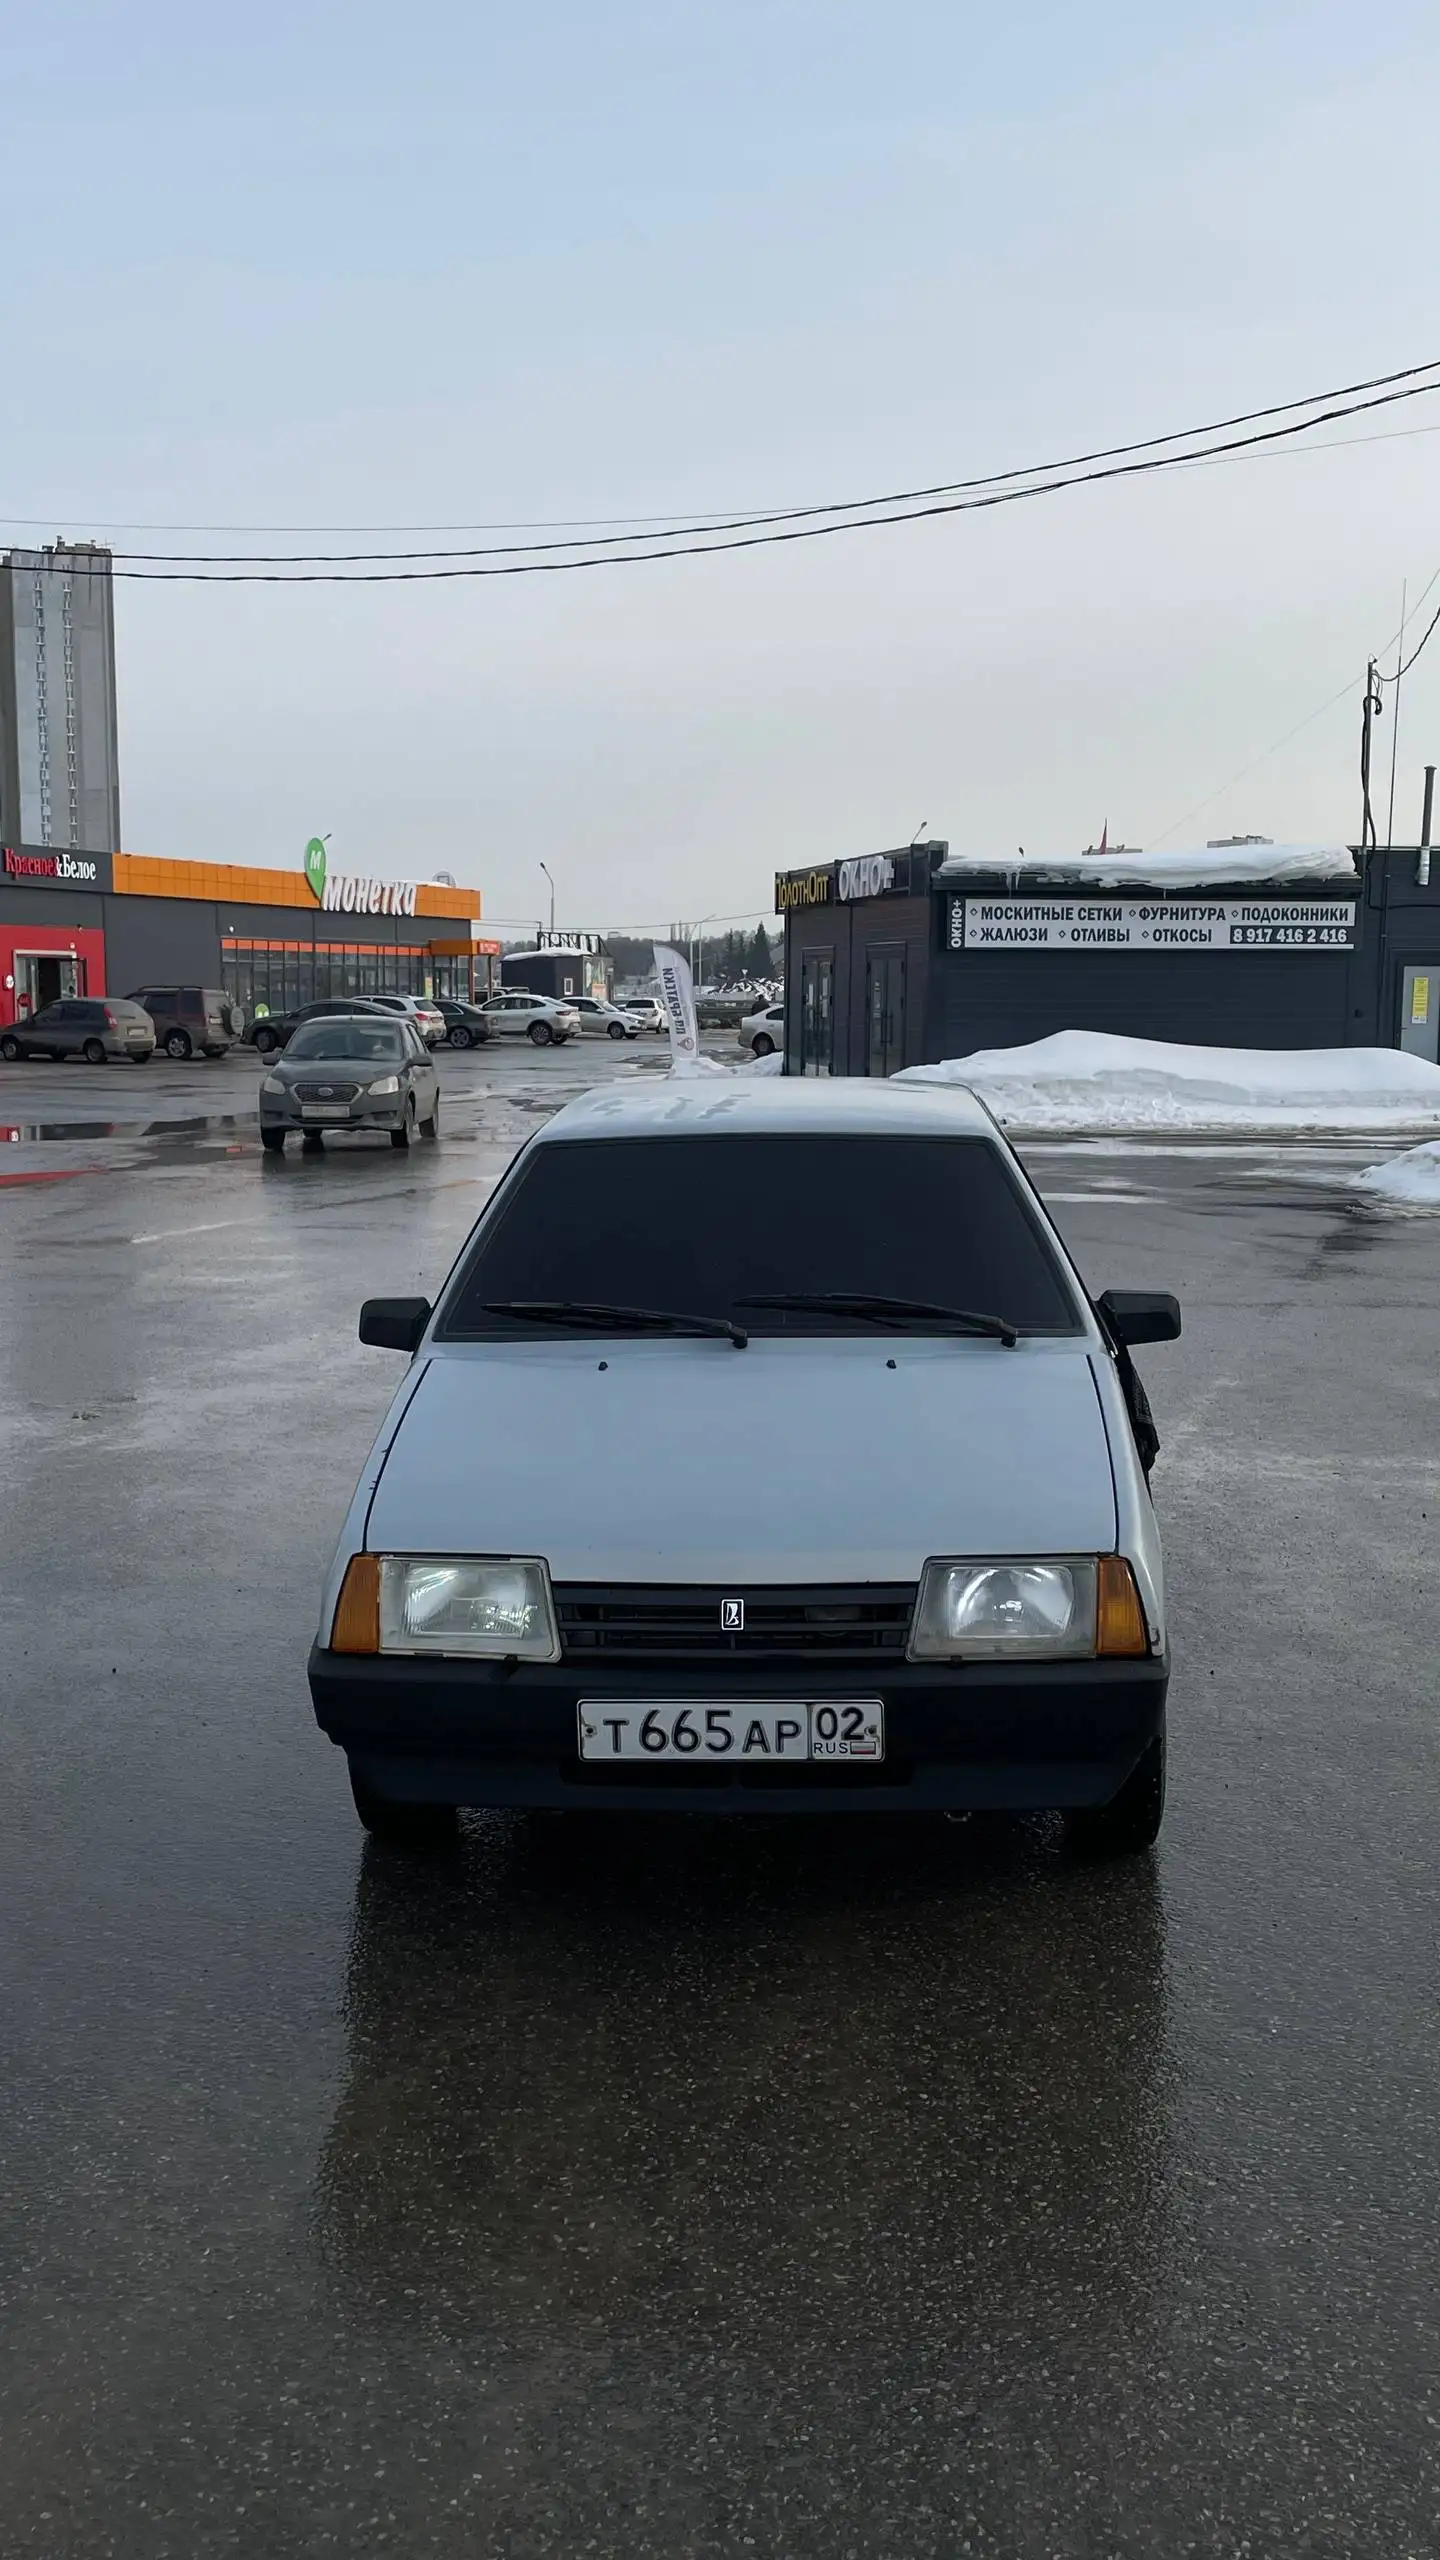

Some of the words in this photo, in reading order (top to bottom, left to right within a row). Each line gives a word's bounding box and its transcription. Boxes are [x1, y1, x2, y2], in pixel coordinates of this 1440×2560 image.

[980, 906, 1074, 921] МОСКИТНЫЕ
[1077, 907, 1123, 921] СЕТКИ
[1138, 907, 1226, 922] ФУРНИТУРА
[1241, 908, 1349, 923] ПОДОКОННИКИ
[951, 900, 963, 948] ОКНО+
[979, 927, 1048, 942] ЖАЛЮЗИ
[1070, 928, 1130, 943] ОТЛИВЫ
[1152, 928, 1212, 943] ОТКОСЫ
[1233, 928, 1244, 943] 8
[1246, 928, 1273, 943] 917
[1276, 928, 1304, 943] 416
[1306, 928, 1317, 943] 2
[1319, 929, 1348, 943] 416
[815, 1706, 865, 1741] 02
[813, 1742, 848, 1755] RUS
